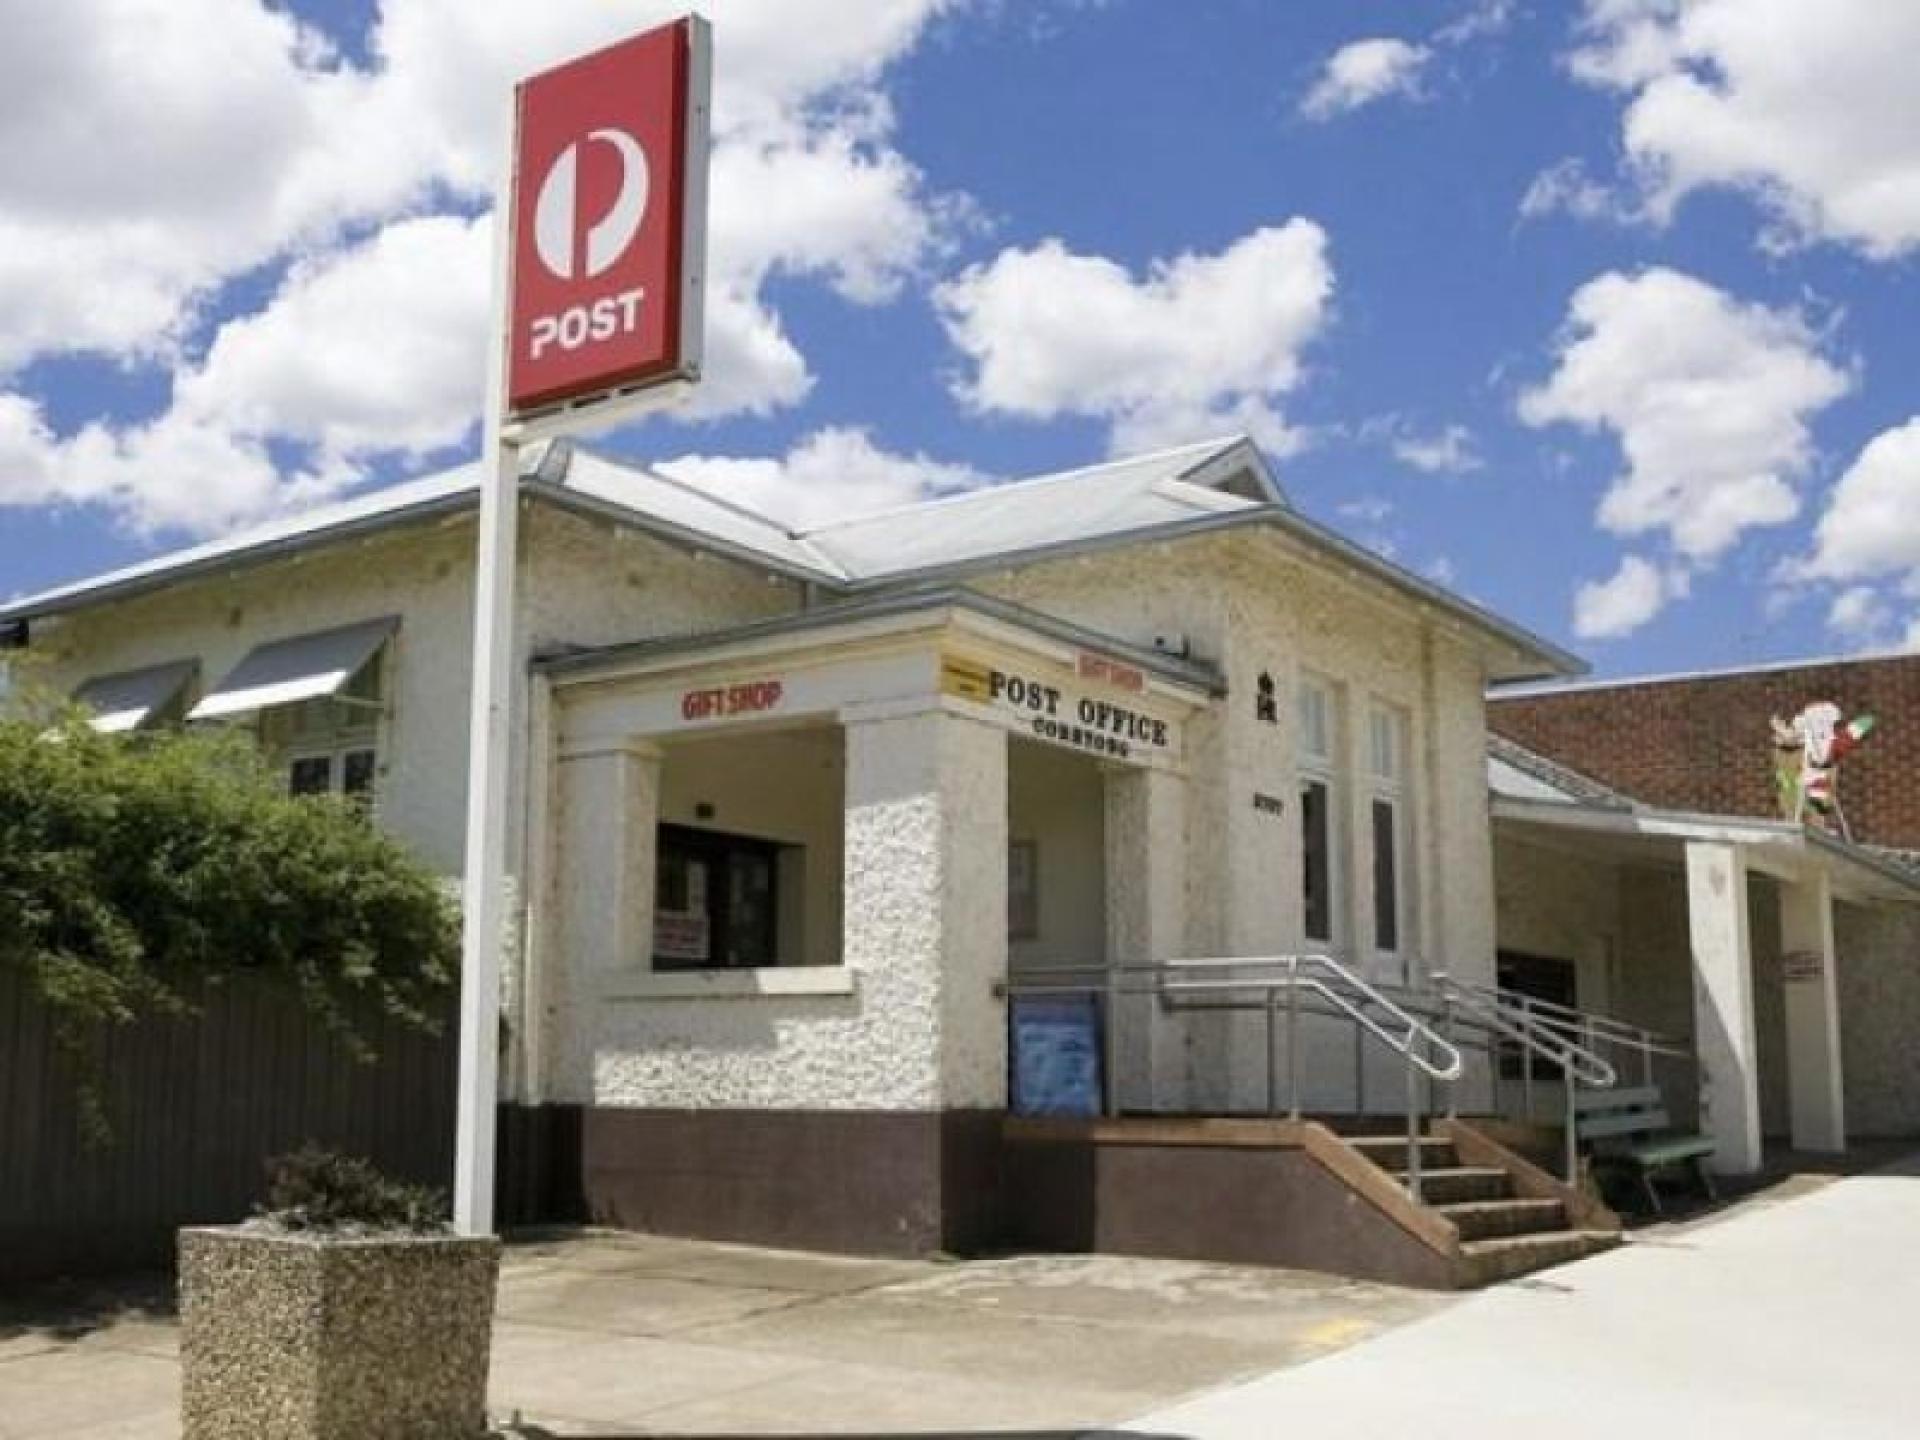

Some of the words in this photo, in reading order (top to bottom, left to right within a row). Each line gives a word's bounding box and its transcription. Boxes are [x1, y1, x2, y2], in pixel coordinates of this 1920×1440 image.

[530, 288, 644, 360] POST
[682, 689, 723, 720] GIFT
[727, 681, 782, 713] SHOP
[988, 671, 1059, 714] POST
[1077, 698, 1168, 746] OFFICE
